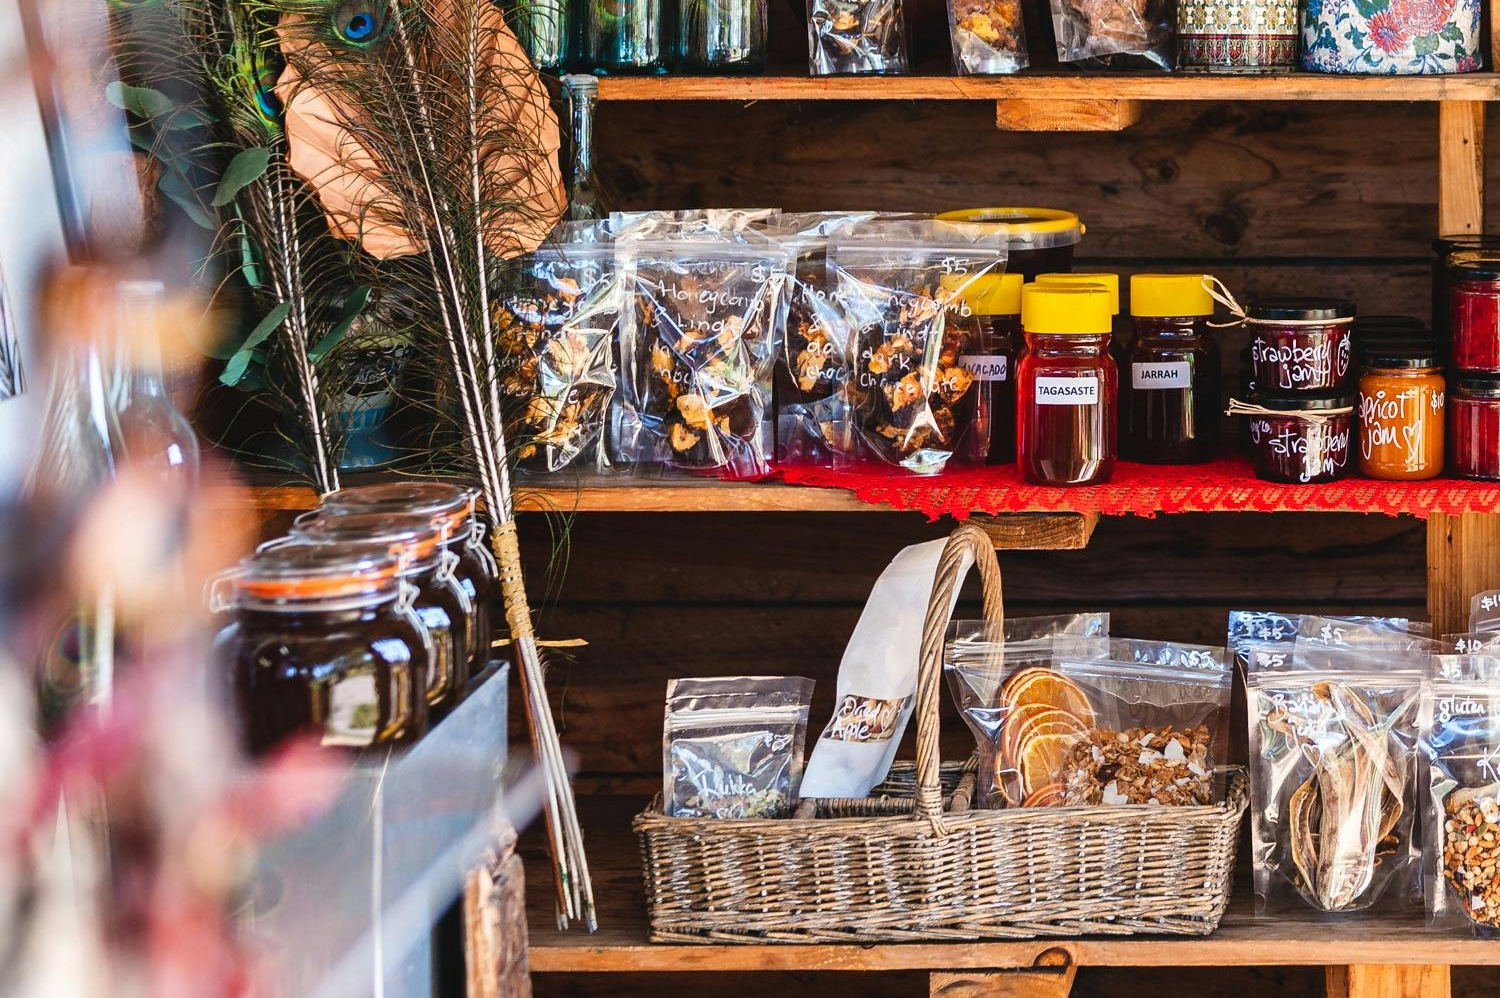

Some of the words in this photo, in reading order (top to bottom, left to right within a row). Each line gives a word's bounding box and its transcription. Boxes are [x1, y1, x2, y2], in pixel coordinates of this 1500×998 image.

[940, 256, 970, 276] $5
[861, 346, 911, 371] dark
[1140, 369, 1178, 380] JARRAH
[1279, 364, 1323, 390] jam
[1038, 385, 1095, 396] TAGASASTE
[1361, 416, 1402, 460] jam
[1320, 622, 1346, 646] $5
[1455, 638, 1482, 654] $10
[1439, 694, 1485, 724] gluten
